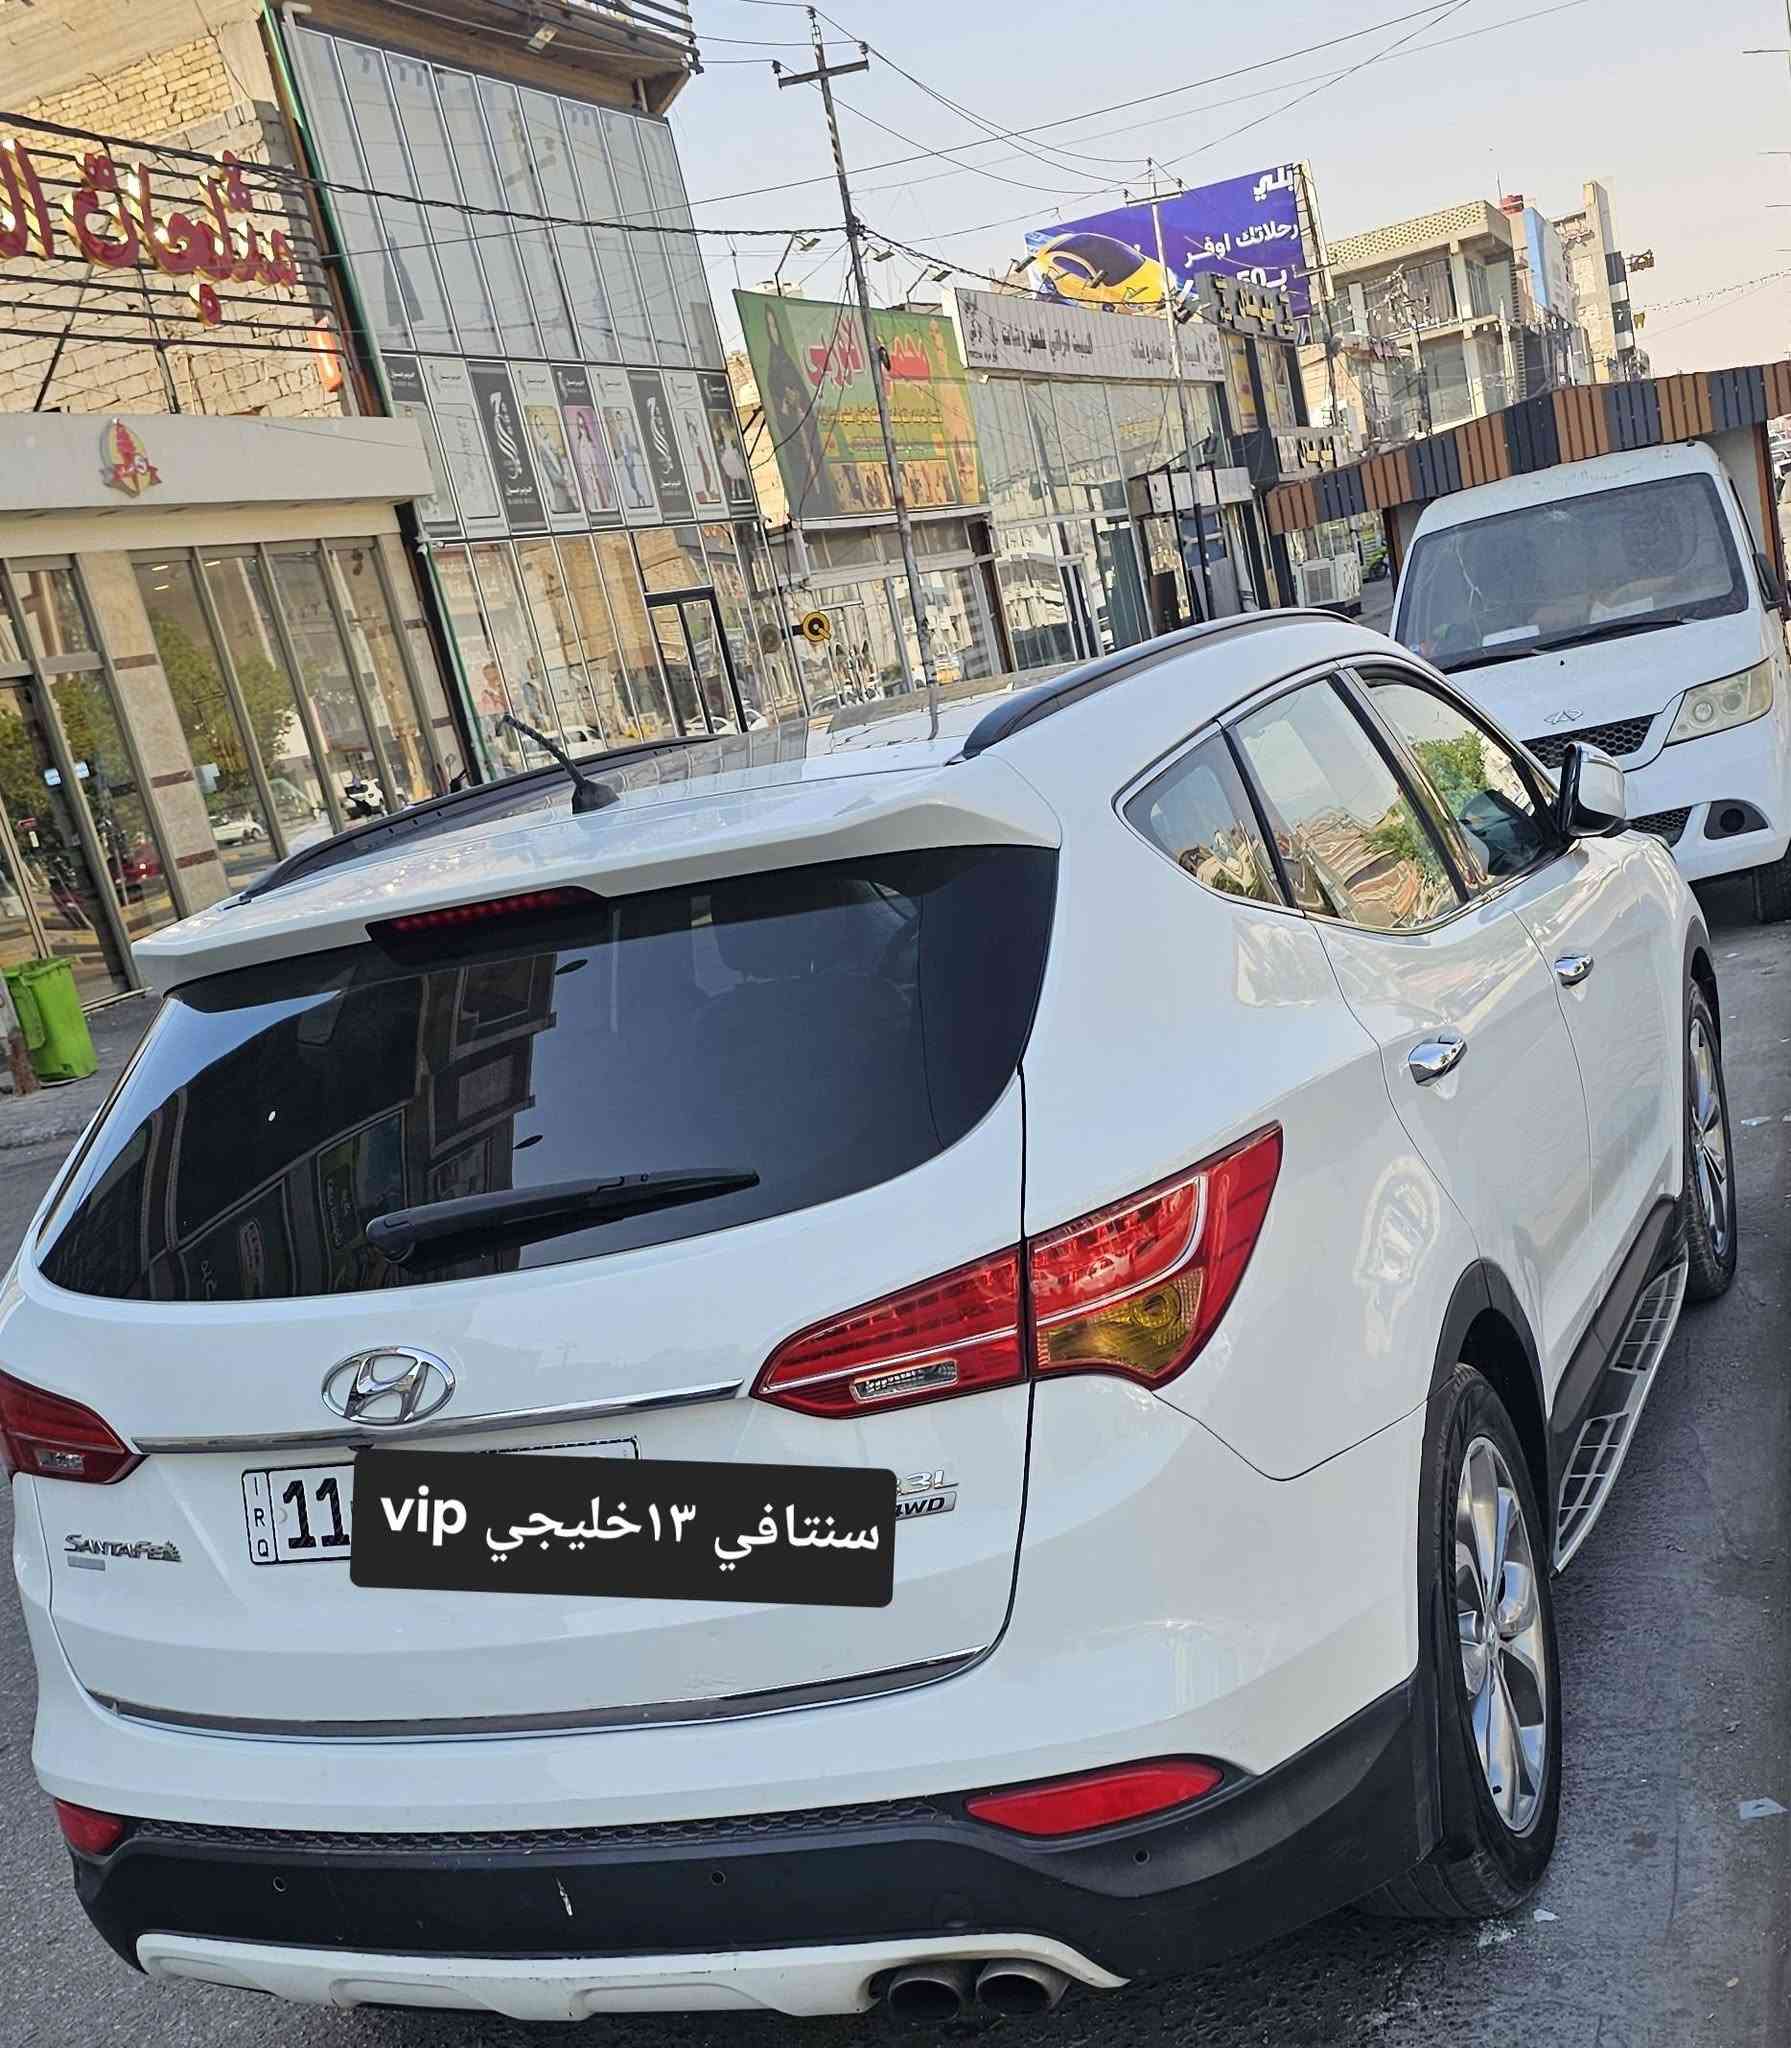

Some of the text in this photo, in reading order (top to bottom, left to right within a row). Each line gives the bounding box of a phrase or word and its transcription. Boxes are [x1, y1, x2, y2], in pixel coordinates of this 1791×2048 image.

[1253, 166, 1293, 201] بلي
[0, 138, 298, 326] مثلجات ال
[1235, 221, 1299, 247] رحلاتك
[282, 1476, 352, 1550] 11
